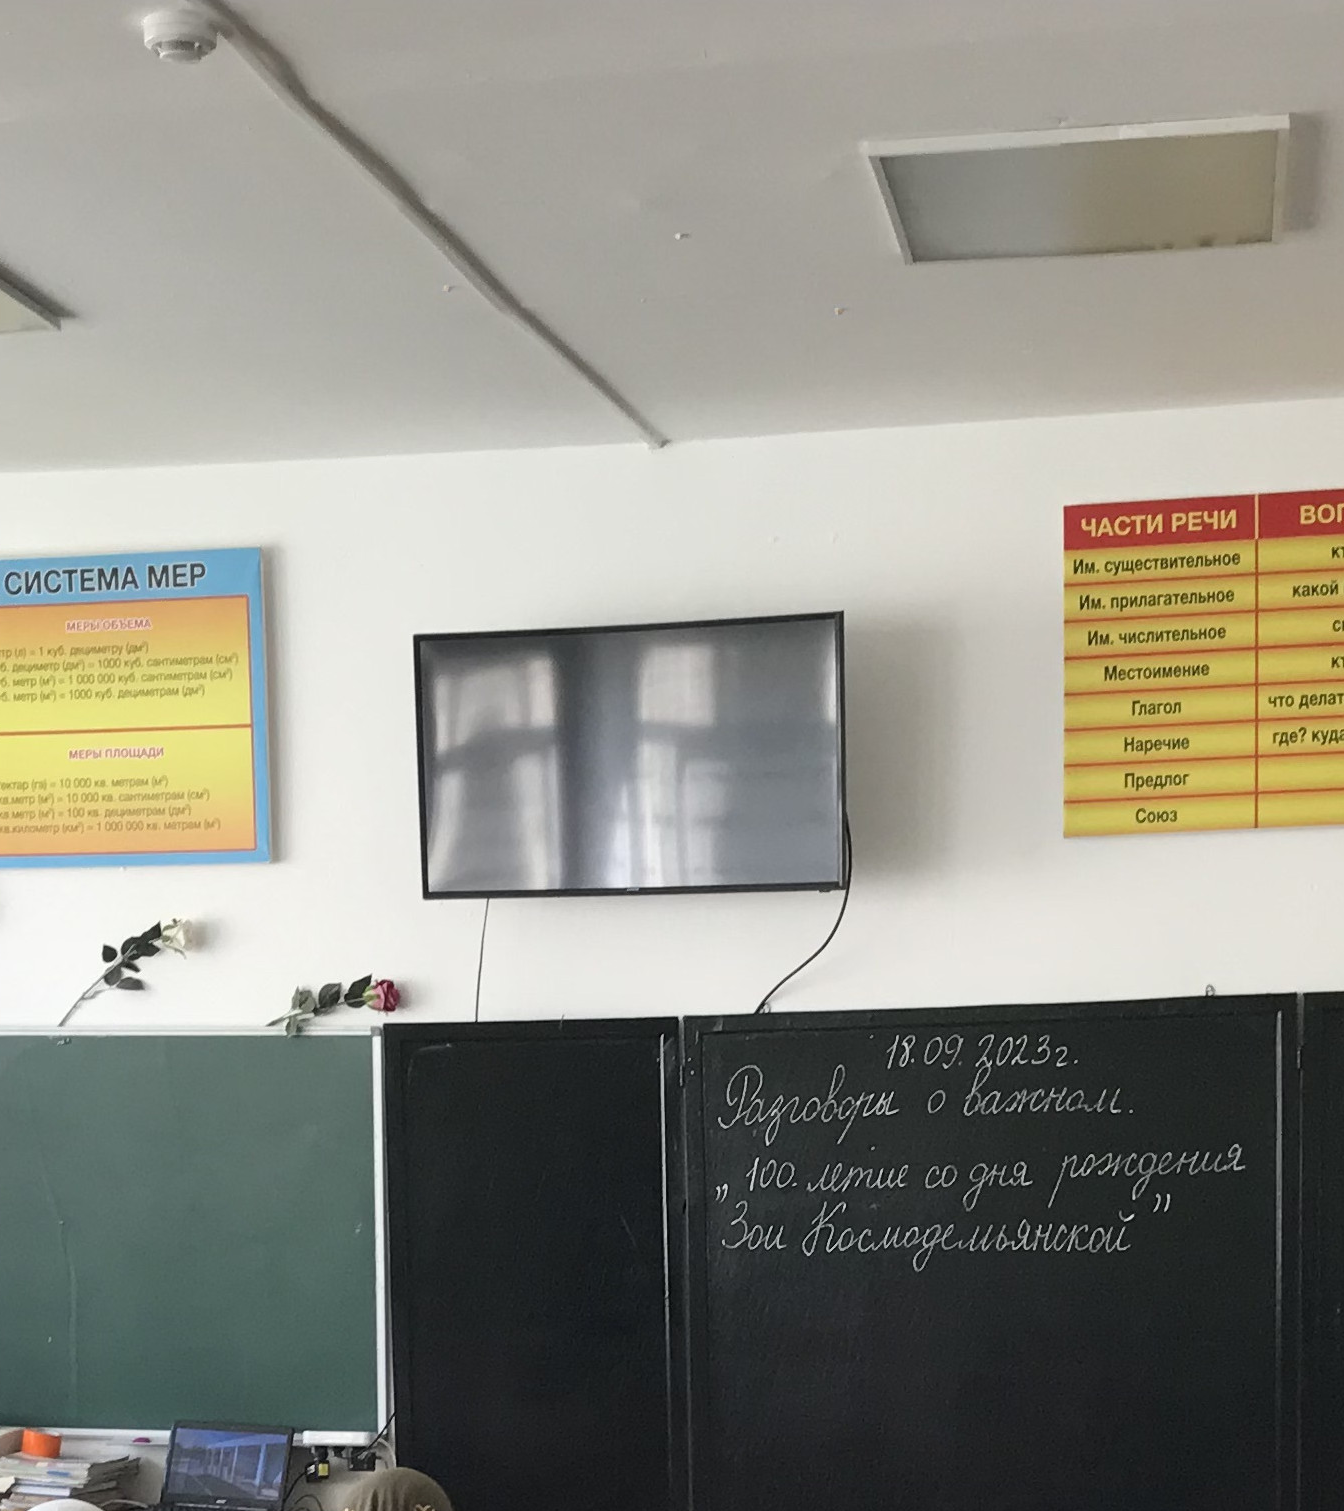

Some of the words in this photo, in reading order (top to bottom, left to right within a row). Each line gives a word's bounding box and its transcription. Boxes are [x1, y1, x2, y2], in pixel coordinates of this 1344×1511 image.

[1080, 513, 1163, 538] ЧАСТИ
[1171, 509, 1237, 533] РЕЧИ
[1073, 558, 1099, 575] Им.
[1104, 553, 1241, 576] существительное
[4, 565, 139, 596] СИСТЕМА
[147, 562, 207, 590] МЕР
[1292, 583, 1339, 597] какой
[1079, 593, 1106, 611] Им.
[1110, 590, 1235, 612] прилагательное
[66, 621, 100, 632] МЕРЫ
[1087, 629, 1113, 646] Им.
[1118, 627, 1226, 644] числительное
[1104, 664, 1210, 681] Местоимение
[1132, 700, 1182, 716] Глагол
[1268, 695, 1294, 707] что
[1124, 737, 1190, 755] Наречие
[1273, 727, 1307, 746] где?
[69, 749, 102, 760] МЕРЫ
[105, 747, 164, 759] ПЛОЩАДИ
[1124, 772, 1189, 791] Предлог
[1135, 808, 1178, 824] Союз
[718, 1064, 899, 1146] Разговоры
[927, 1089, 946, 1114] о
[963, 1066, 1134, 1116] важном.
[807, 1163, 909, 1192] летие
[925, 1164, 958, 1189] со
[962, 1160, 1033, 1212] дня
[1047, 1143, 1246, 1208] рождения
[721, 1200, 787, 1250] Зои
